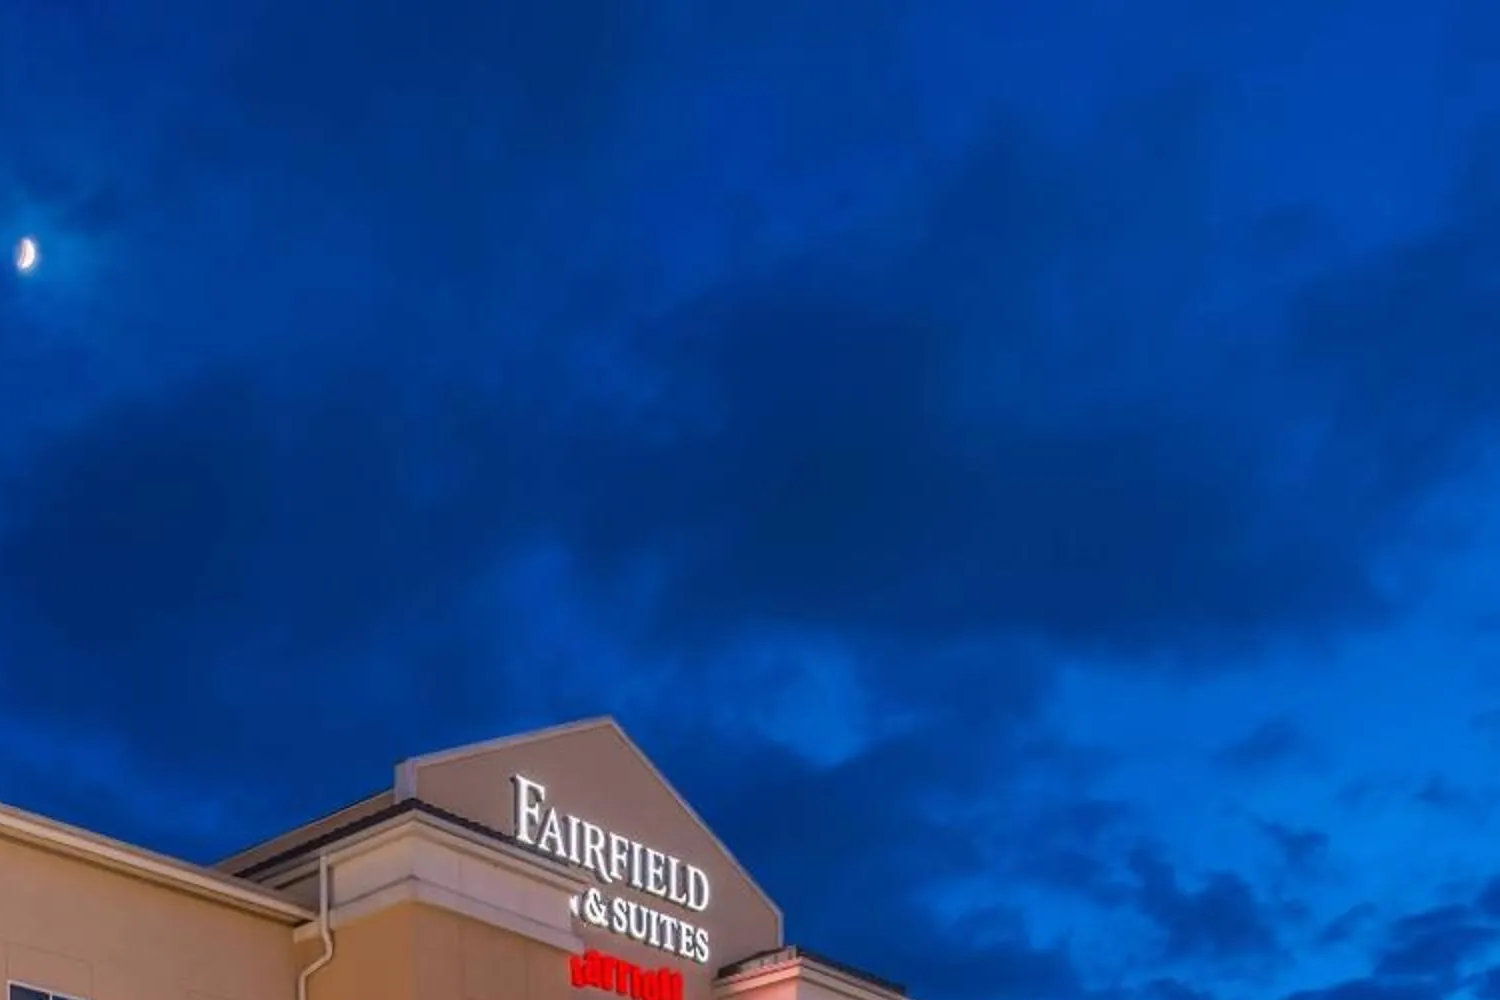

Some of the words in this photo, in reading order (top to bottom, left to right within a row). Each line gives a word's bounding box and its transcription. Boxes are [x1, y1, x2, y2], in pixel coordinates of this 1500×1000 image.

[514, 773, 710, 912] FAIRFIELD
[584, 887, 609, 928] &
[612, 897, 710, 963] SUITES
